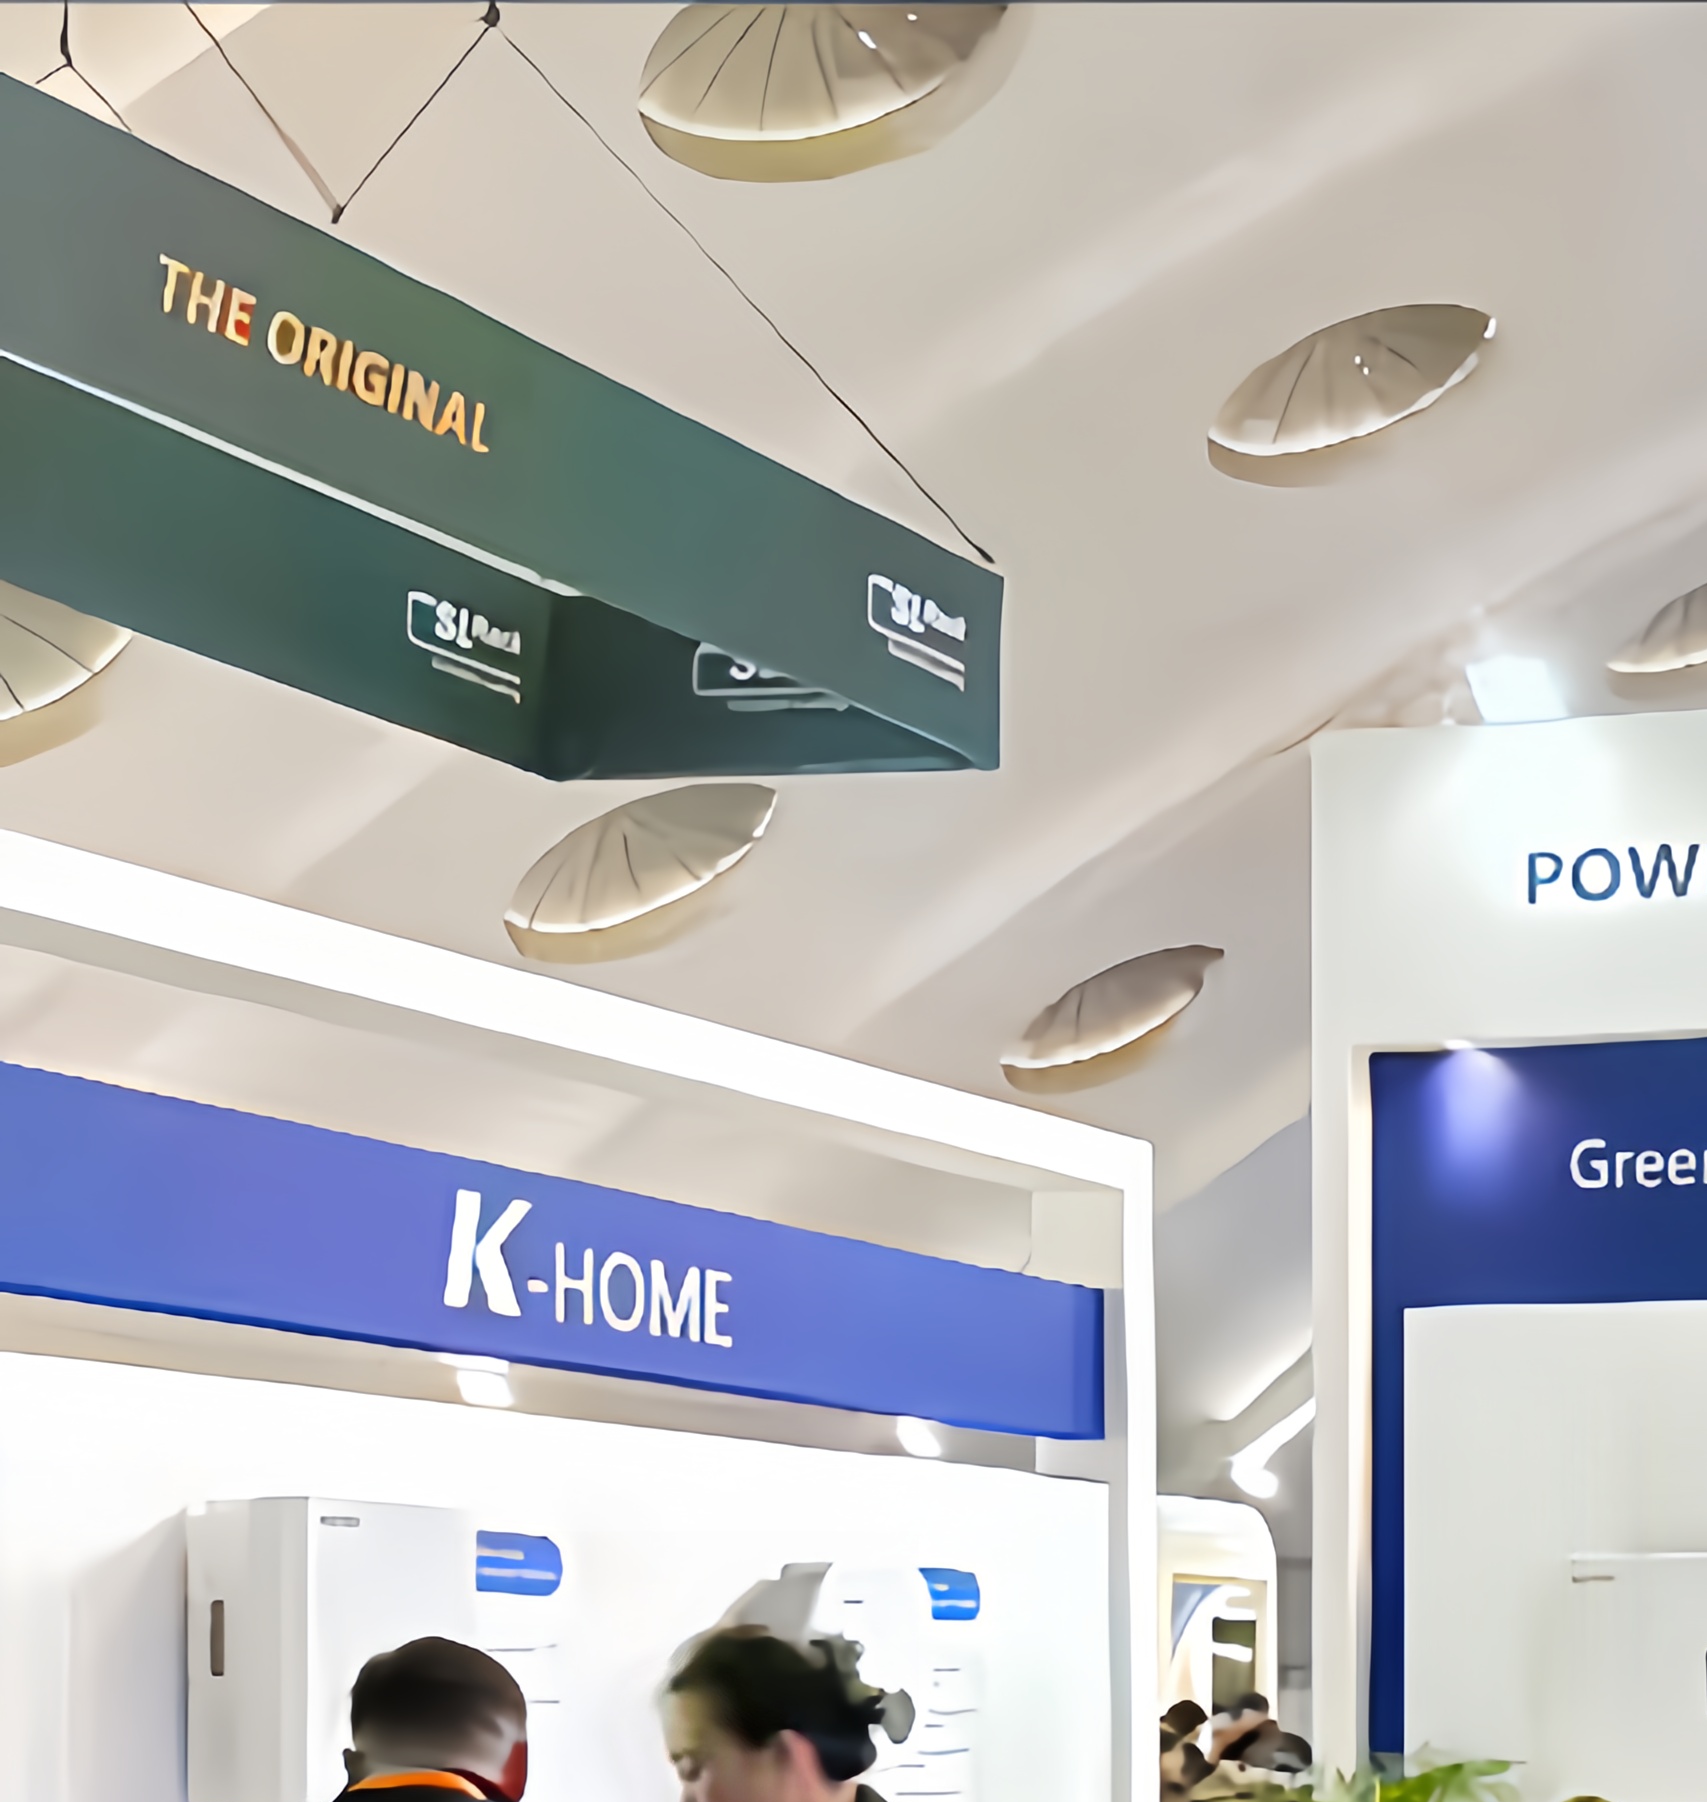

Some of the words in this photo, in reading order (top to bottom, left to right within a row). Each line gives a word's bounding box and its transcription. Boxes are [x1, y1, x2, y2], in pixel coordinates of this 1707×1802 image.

[158, 252, 258, 347] THE
[266, 310, 490, 454] ORIGINAL
[442, 1189, 733, 1349] K-HOME
